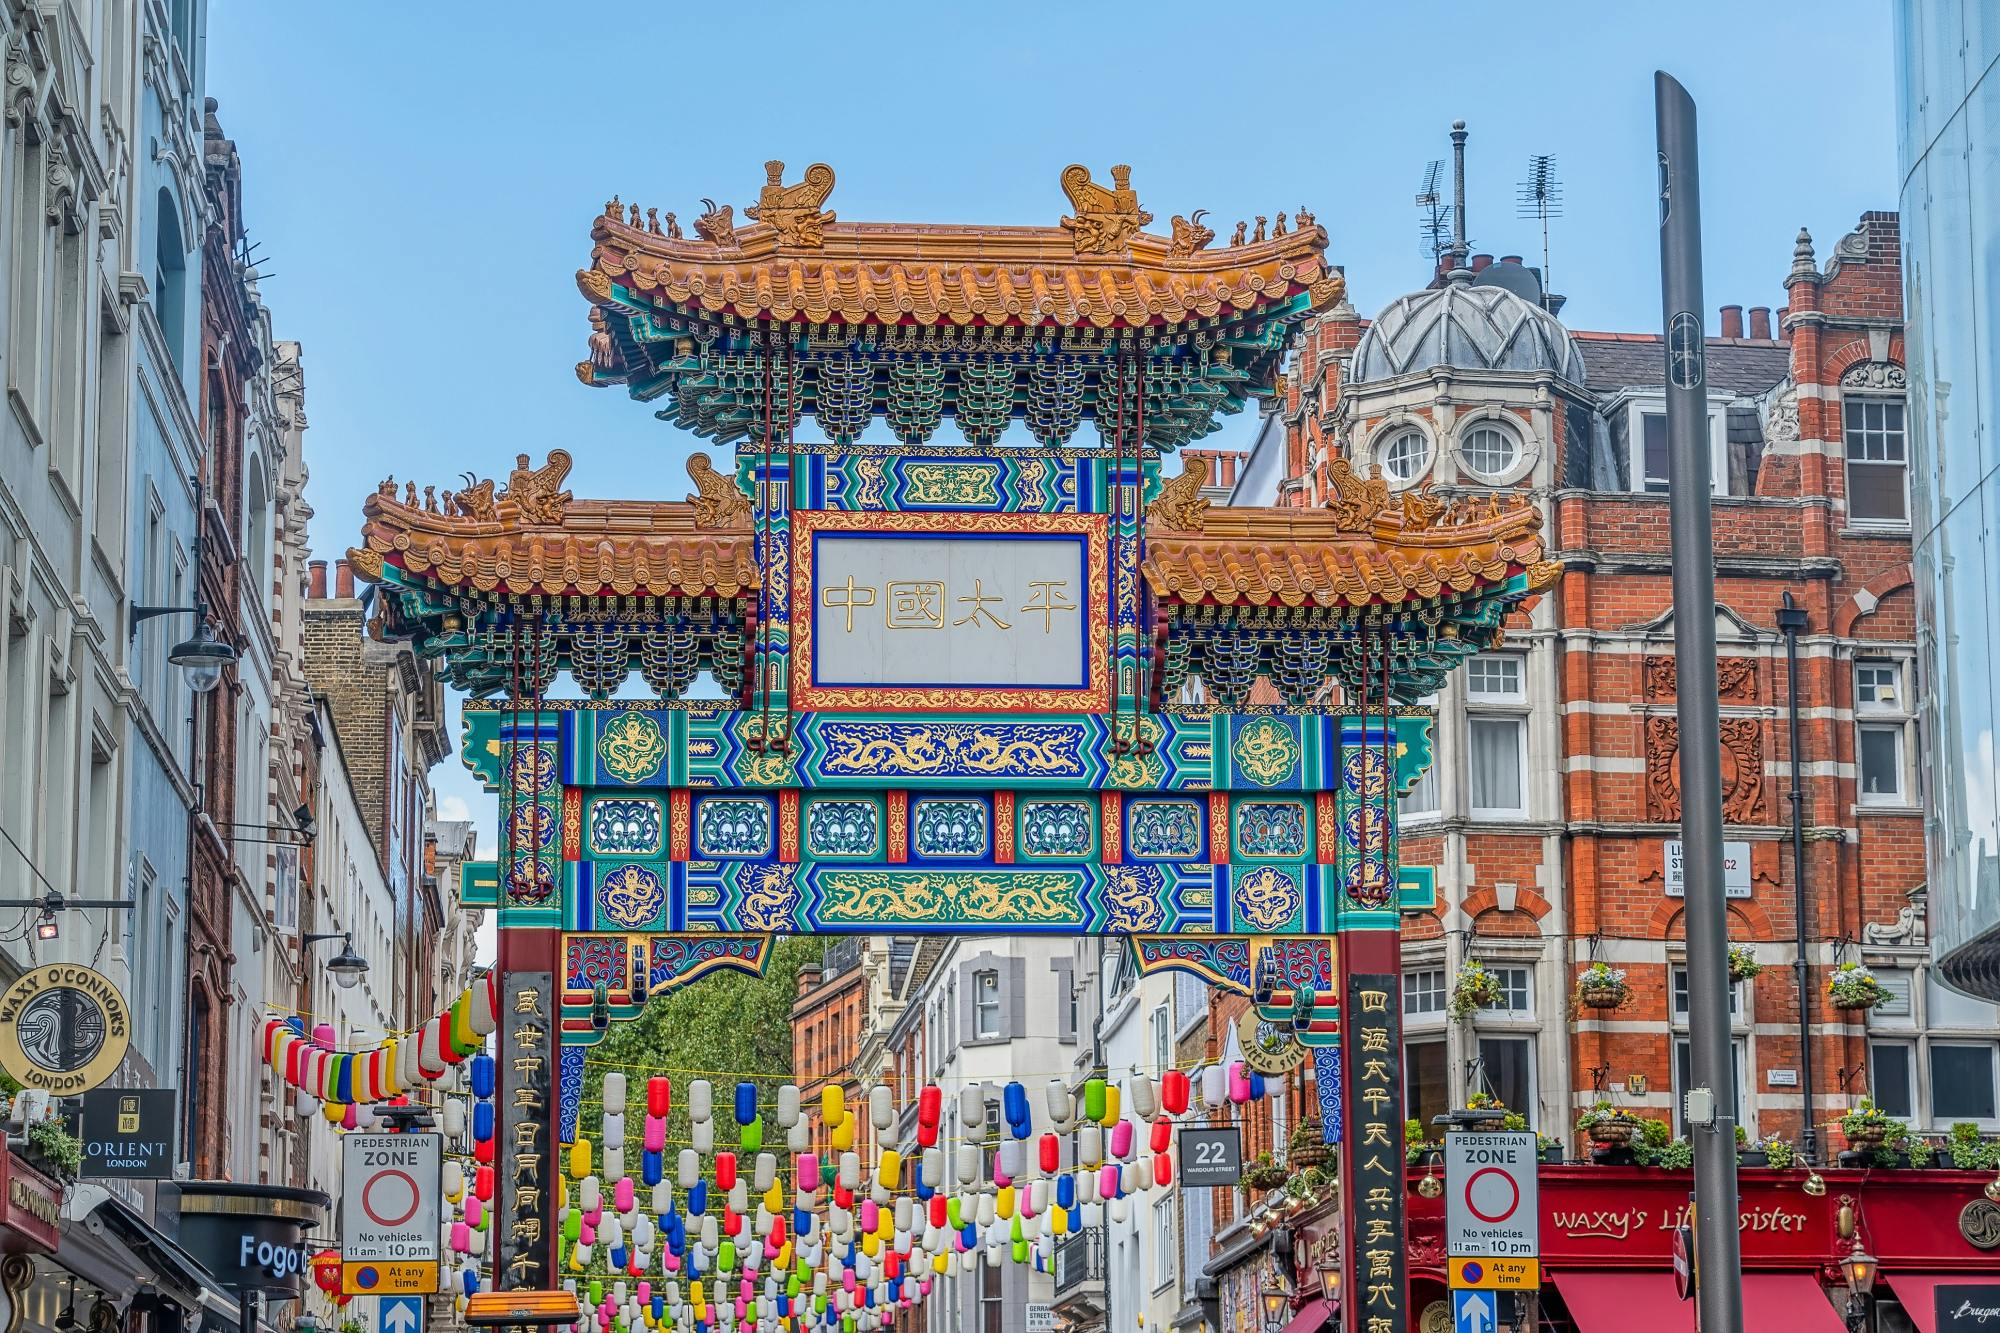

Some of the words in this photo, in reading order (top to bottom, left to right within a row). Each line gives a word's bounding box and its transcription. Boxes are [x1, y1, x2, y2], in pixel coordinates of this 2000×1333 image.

[822, 575, 1077, 633] 中國太平
[1724, 859, 1737, 870] C2
[1, 974, 40, 1023] WAXY
[48, 968, 125, 1036] O'CONNOR'S
[24, 1068, 87, 1089] LONDON
[354, 1138, 430, 1148] PEDESTRIAN
[1455, 1136, 1527, 1146] PEDESTRIAN
[87, 1142, 167, 1156] ORIENT
[1195, 1141, 1226, 1164] 22
[364, 1151, 418, 1166] ZONE
[1465, 1149, 1517, 1164] ZONE
[106, 1159, 147, 1168] LONDON
[359, 1233, 374, 1242] No
[378, 1232, 423, 1242] vehicles
[1463, 1229, 1477, 1238] No
[1481, 1228, 1523, 1238] vehicles
[388, 1244, 405, 1256] 10
[408, 1247, 431, 1258] pm
[1491, 1241, 1507, 1253] 10
[1510, 1243, 1531, 1254] pm
[240, 1234, 298, 1278] Fogo
[389, 1267, 402, 1276] At
[405, 1269, 424, 1279] any
[1493, 1264, 1505, 1273] At
[1507, 1266, 1526, 1275] any
[395, 1278, 418, 1287] time
[1498, 1274, 1521, 1283] time
